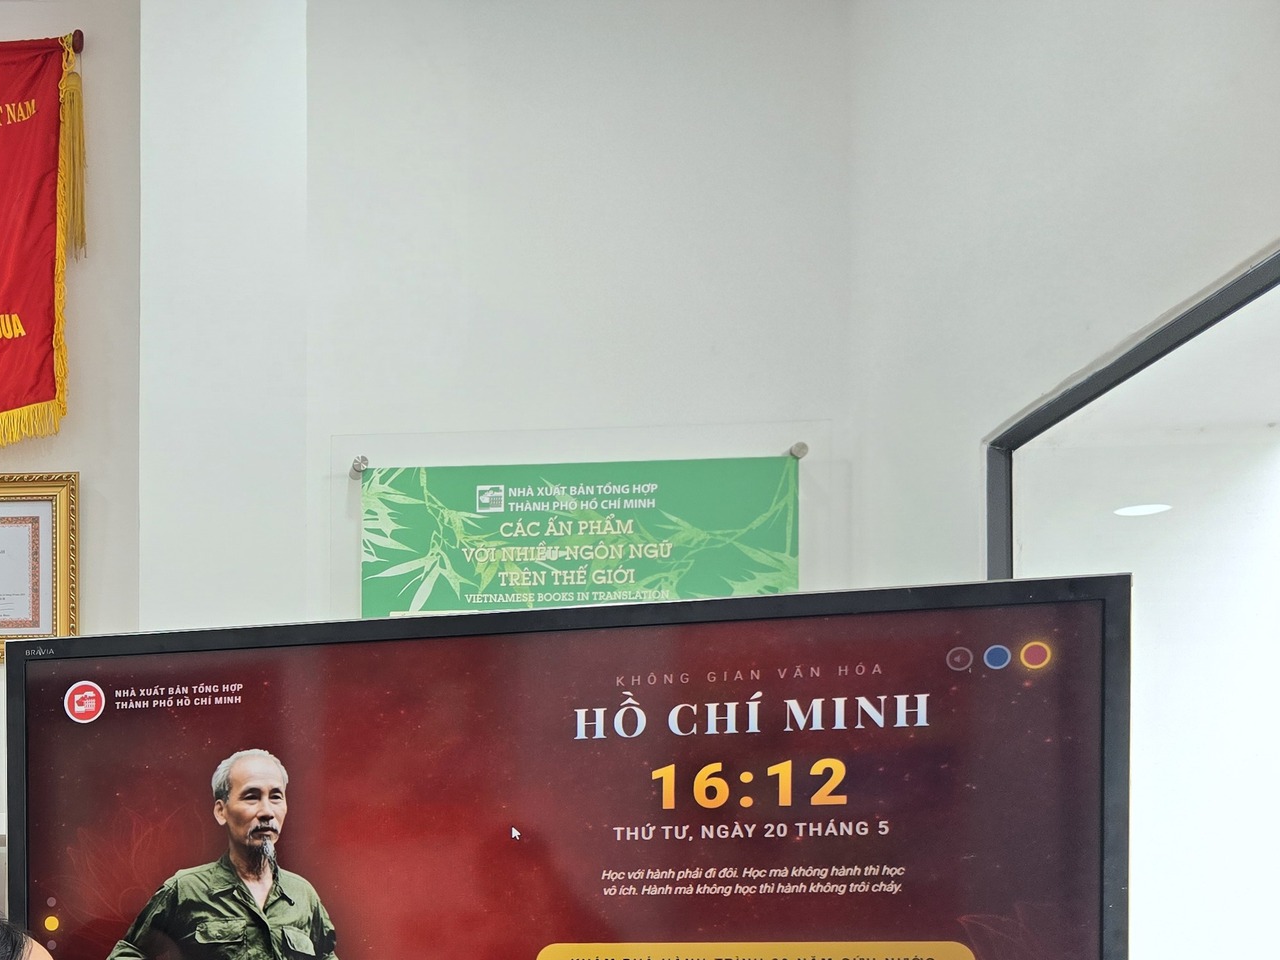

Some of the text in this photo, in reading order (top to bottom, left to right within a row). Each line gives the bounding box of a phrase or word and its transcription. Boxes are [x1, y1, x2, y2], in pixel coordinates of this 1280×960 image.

[5, 99, 36, 124] NAM
[509, 483, 658, 496] NHÀ XUẤT BẢN TỔNG HỢP
[509, 500, 549, 512] THÀNH
[553, 499, 577, 511] PHỐ
[601, 498, 620, 510] CHÍ
[624, 499, 655, 508] MINH
[500, 514, 633, 537] CÁC ẤN PHẨM
[462, 541, 673, 563] VỚI NHIỀU NGÔN NGỮ
[498, 564, 636, 586] TRÊN THẾ GIỚI
[464, 590, 670, 603] VIETNAMESE BOOKS IN TRANSLATION
[26, 647, 54, 655] BRAVIA
[617, 662, 881, 686] KHÔNG GIAN VĂN HÓA
[115, 683, 243, 697] NHÀ XUẤT BẢN TỔNG HỢP
[115, 696, 241, 709] THÀNH PHỐ HỒ CHÍ MINH
[574, 691, 930, 739] HỒ CHÍ MINH
[652, 758, 847, 809] 16:12
[613, 819, 889, 841] THỨ TƯ, NGÀY 20 THÁNG 5
[601, 865, 905, 881] Học với hành phải đi đôi. Học mà không hành thì học
